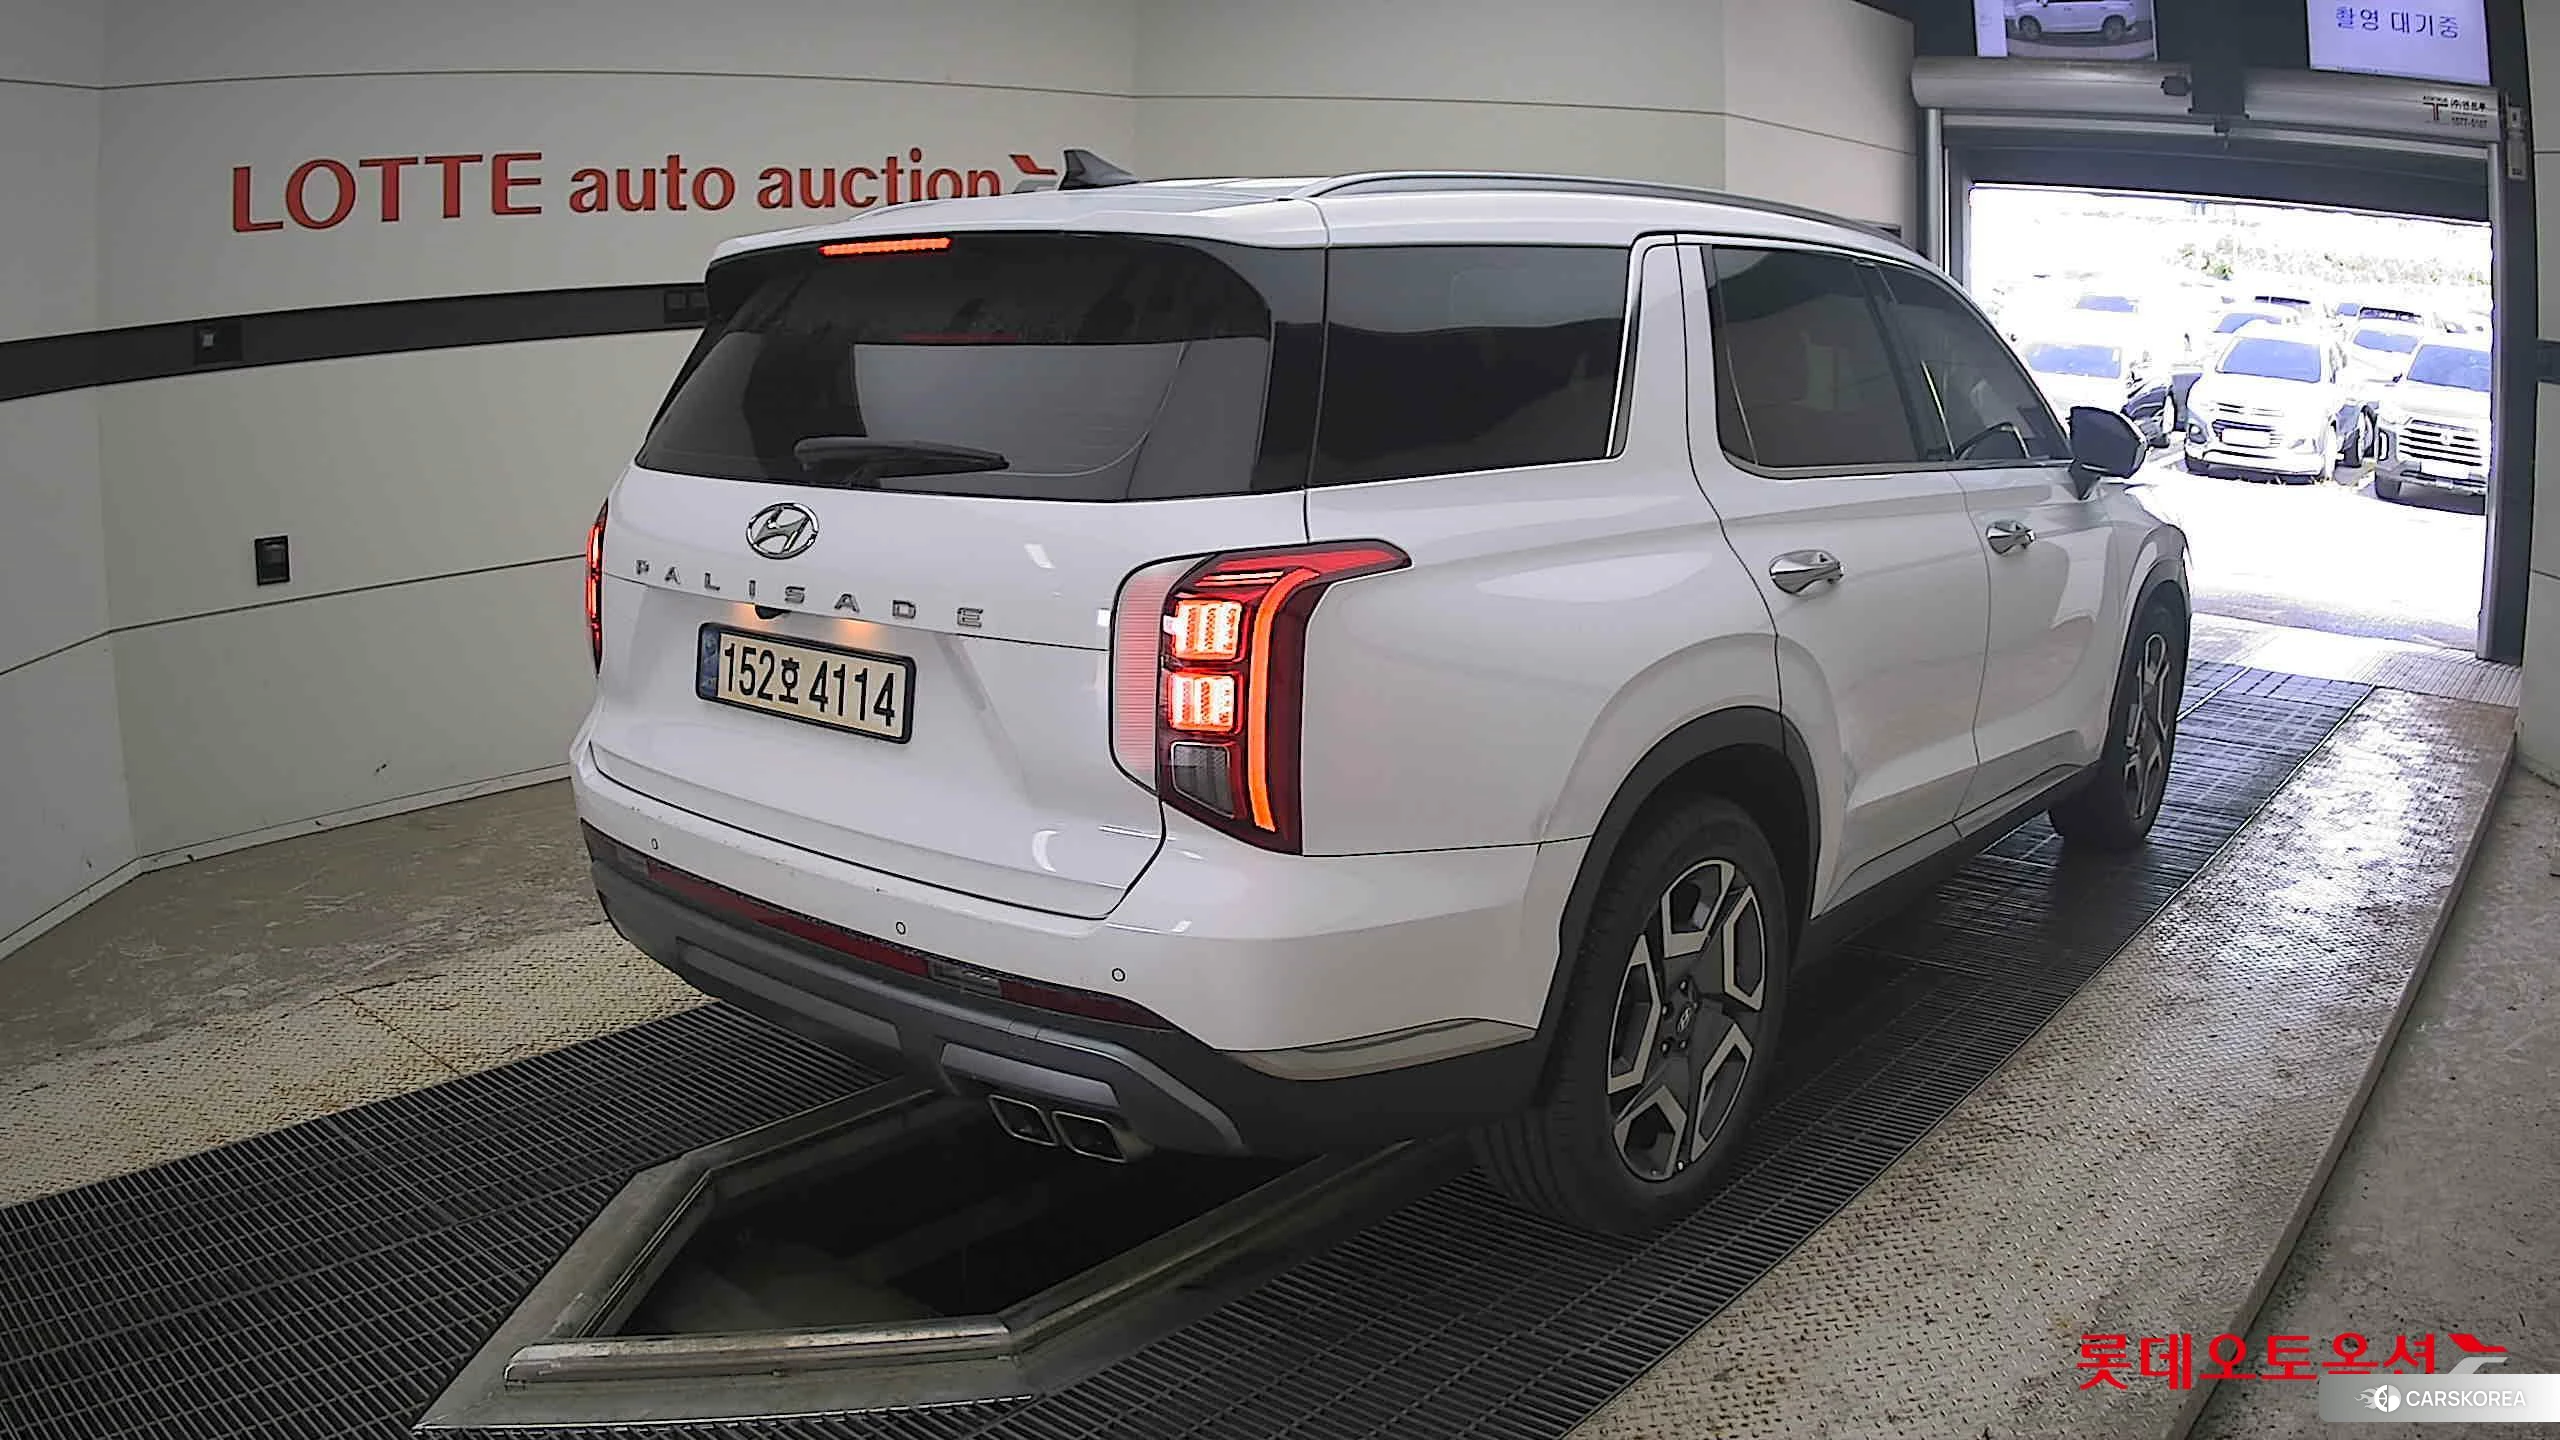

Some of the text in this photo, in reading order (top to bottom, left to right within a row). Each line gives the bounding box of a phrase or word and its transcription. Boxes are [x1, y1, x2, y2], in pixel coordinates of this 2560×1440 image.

[2336, 5, 2461, 40] 촬영 대기중
[232, 146, 1001, 233] LOTTE auto auction
[635, 559, 985, 629] PALISADE
[724, 642, 897, 728] 152호 4114
